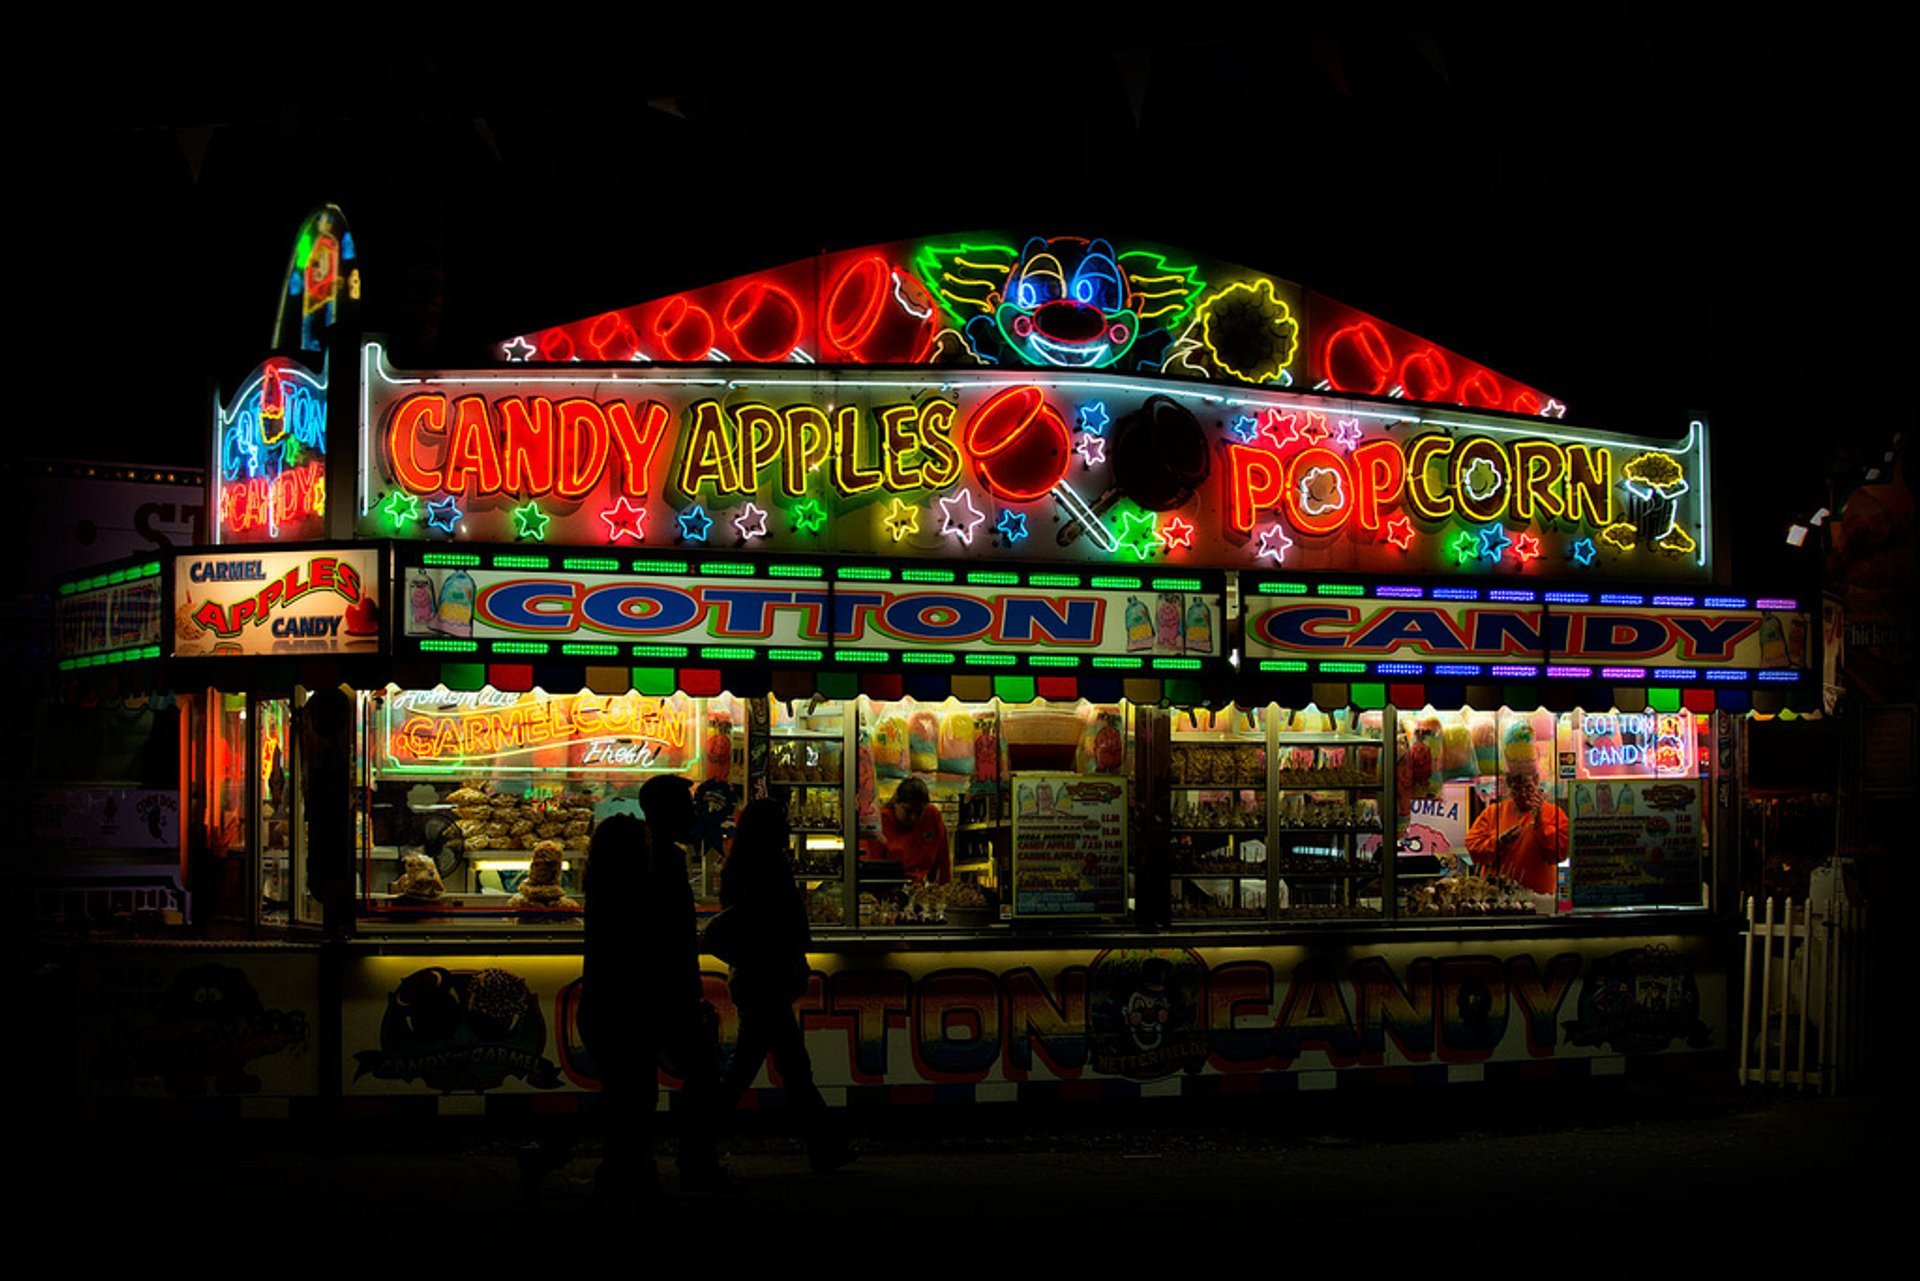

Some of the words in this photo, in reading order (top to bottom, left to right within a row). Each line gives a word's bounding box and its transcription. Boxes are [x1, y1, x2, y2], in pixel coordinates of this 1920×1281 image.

[388, 394, 671, 497] CANDY
[682, 398, 963, 496] APPLES
[229, 461, 318, 532] CANDY
[1228, 434, 1613, 533] POPCORN
[190, 560, 266, 582] CARMEL
[192, 557, 361, 638] APPLES
[271, 615, 343, 638] CANDY
[478, 582, 1105, 646] COTTON
[1250, 605, 1762, 659] CANDY
[403, 695, 687, 756] CARMELCORN
[1584, 714, 1654, 735] COTTON
[583, 740, 656, 768] Fresh
[1589, 744, 1649, 767] CANDY
[1446, 802, 1459, 821] A
[1208, 954, 1580, 1071] CANDY
